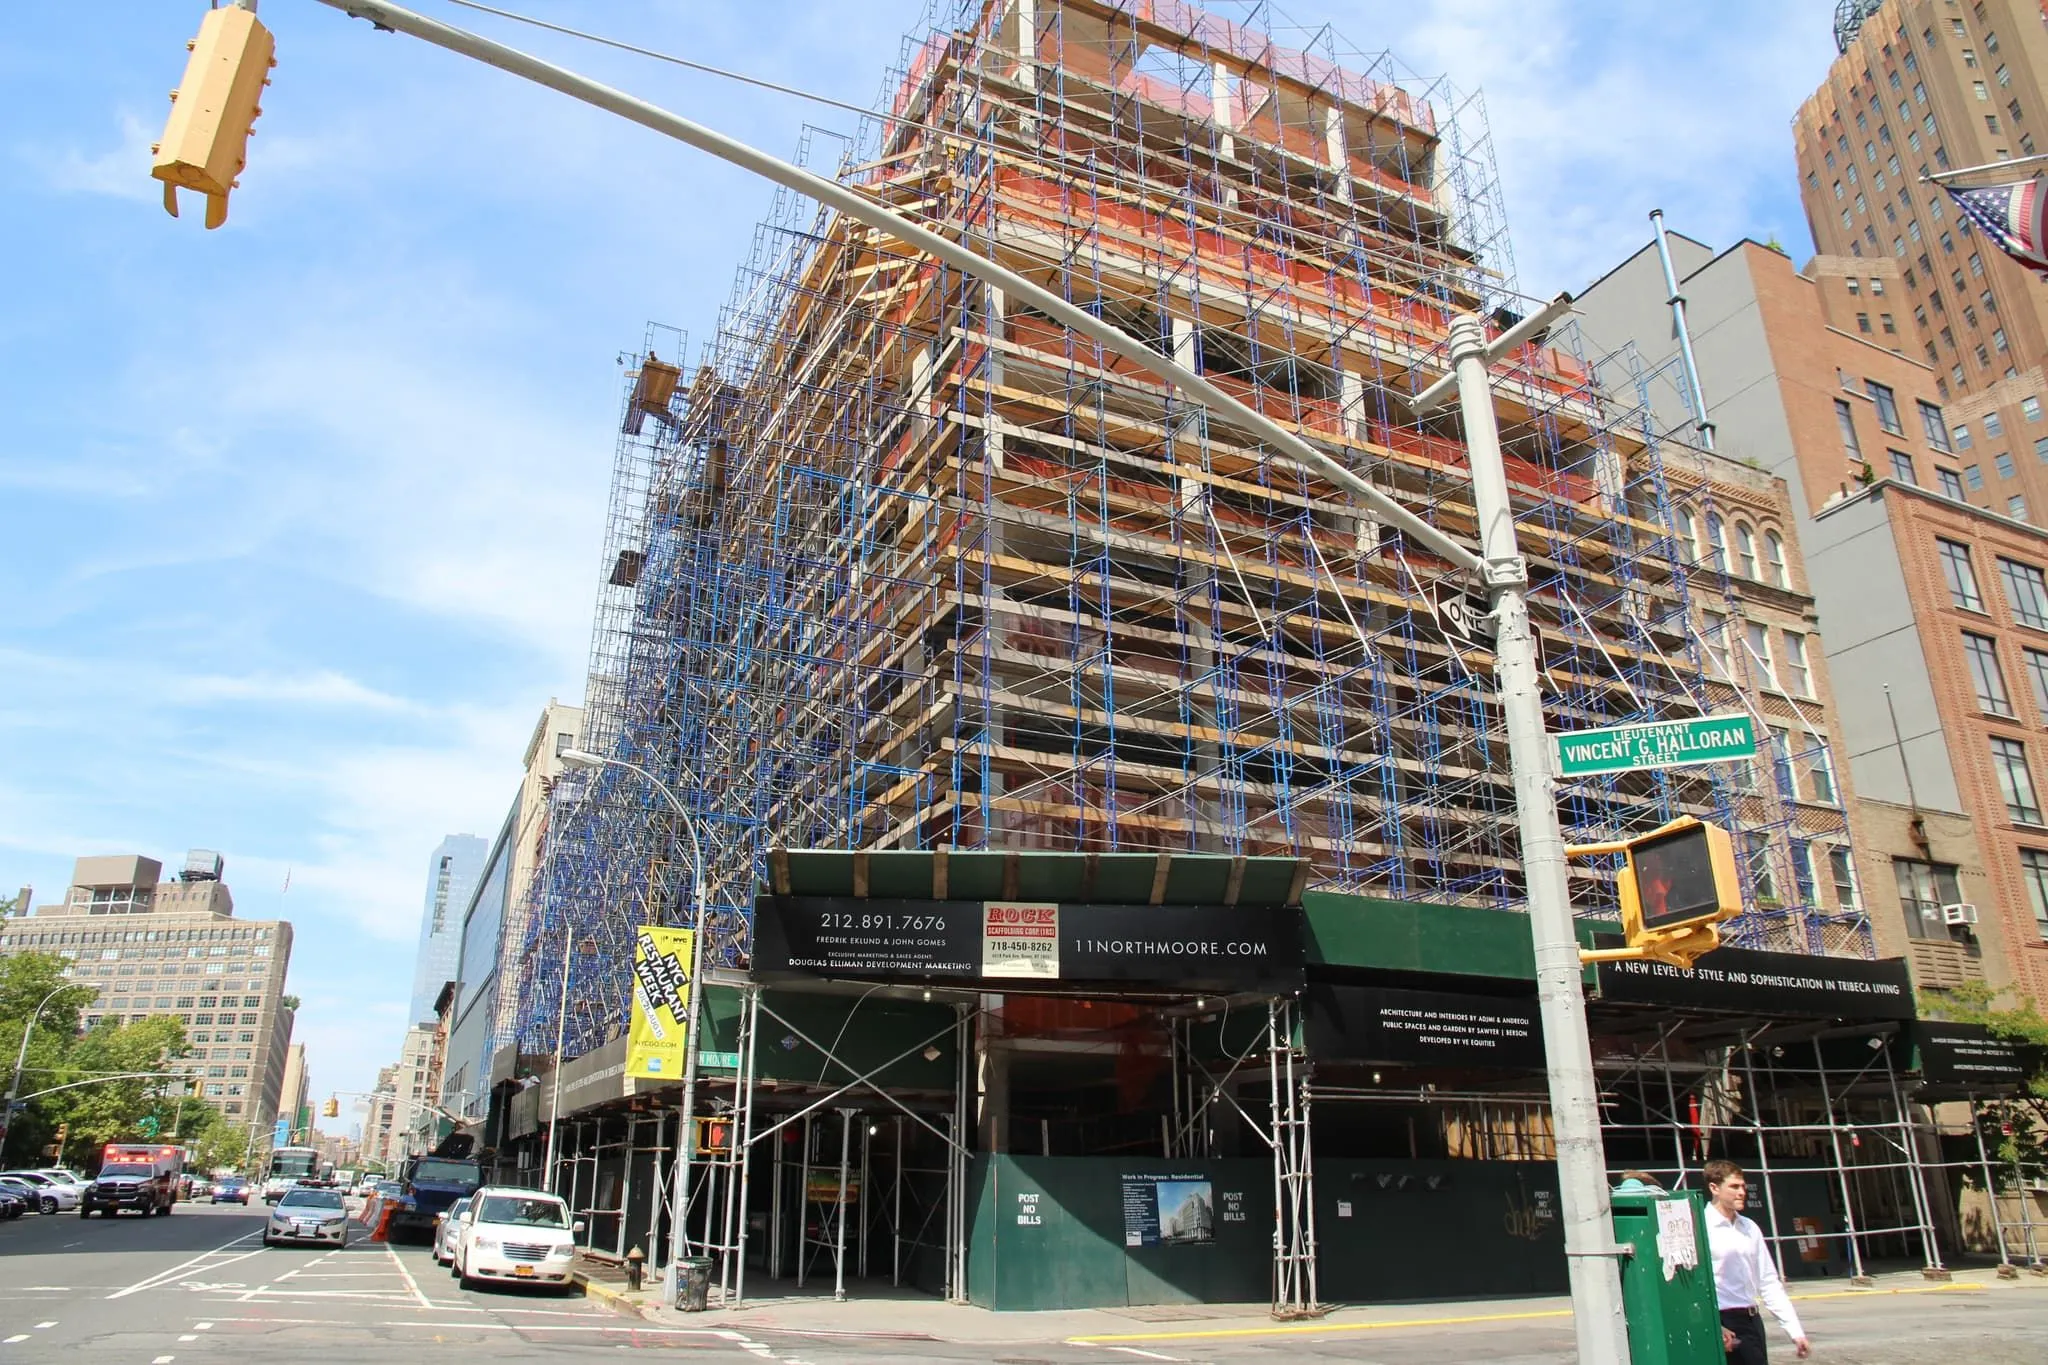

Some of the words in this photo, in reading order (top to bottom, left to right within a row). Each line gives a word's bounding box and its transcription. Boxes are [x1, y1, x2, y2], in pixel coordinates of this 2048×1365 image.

[1613, 725, 1690, 742] LIEUTENANT
[1565, 741, 1631, 763] VINCENT
[1638, 738, 1651, 755] G.
[1656, 728, 1746, 753] HALLORAN
[1632, 752, 1680, 767] STREET
[821, 913, 946, 931] 212.891.7676
[987, 908, 1055, 924] ROCK
[816, 936, 847, 944] FREDRIK
[850, 937, 880, 945] EKLUND
[891, 938, 914, 946] JOHN
[991, 941, 1053, 952] 718-450-8262
[1075, 939, 1267, 955] 11NORTHMOORE.COM
[664, 954, 687, 986] NYC
[788, 958, 827, 967] DOUGLAS
[830, 959, 864, 968] ELLIMAN
[866, 960, 922, 969] DEVELOPMENT
[925, 961, 972, 970] MARKETING
[638, 934, 688, 1023] RESTAURANT
[1615, 961, 1622, 972] A
[1625, 962, 1649, 974] NEW
[1653, 964, 1679, 977] LEVEL
[1682, 967, 1695, 979] OF
[1698, 968, 1725, 982] STYLE
[1728, 971, 1747, 984] AND
[1750, 974, 1823, 991] SOPHISTICATION
[1826, 980, 1836, 991] IN
[1838, 981, 1871, 993] TRIBECA
[1873, 983, 1900, 995] LIVING
[1380, 1008, 1423, 1018] ARCHITECTURE
[1424, 1011, 1438, 1019] AND
[1438, 1012, 1468, 1021] INTERIORS
[1502, 1017, 1529, 1025] ANDREOLI
[1383, 1021, 1403, 1029] PUBLIC
[1404, 1022, 1426, 1031] SPACES
[1428, 1023, 1442, 1032] AND
[1442, 1024, 1466, 1033] GARDEN
[1468, 1026, 1476, 1034] BY
[1476, 1027, 1499, 1035] SAWYER
[1506, 1029, 1528, 1037] BERSON
[1419, 1035, 1451, 1045] DEVELOPED
[1453, 1037, 1461, 1045] BY
[1462, 1038, 1469, 1046] VE
[1471, 1038, 1496, 1047] EQUITIES
[1018, 1193, 1040, 1203] POST
[1223, 1192, 1243, 1201] POST
[1023, 1205, 1036, 1214] NO
[1228, 1202, 1240, 1211] NO
[1017, 1215, 1042, 1225] BILLS
[1223, 1212, 1246, 1221] BILLS
